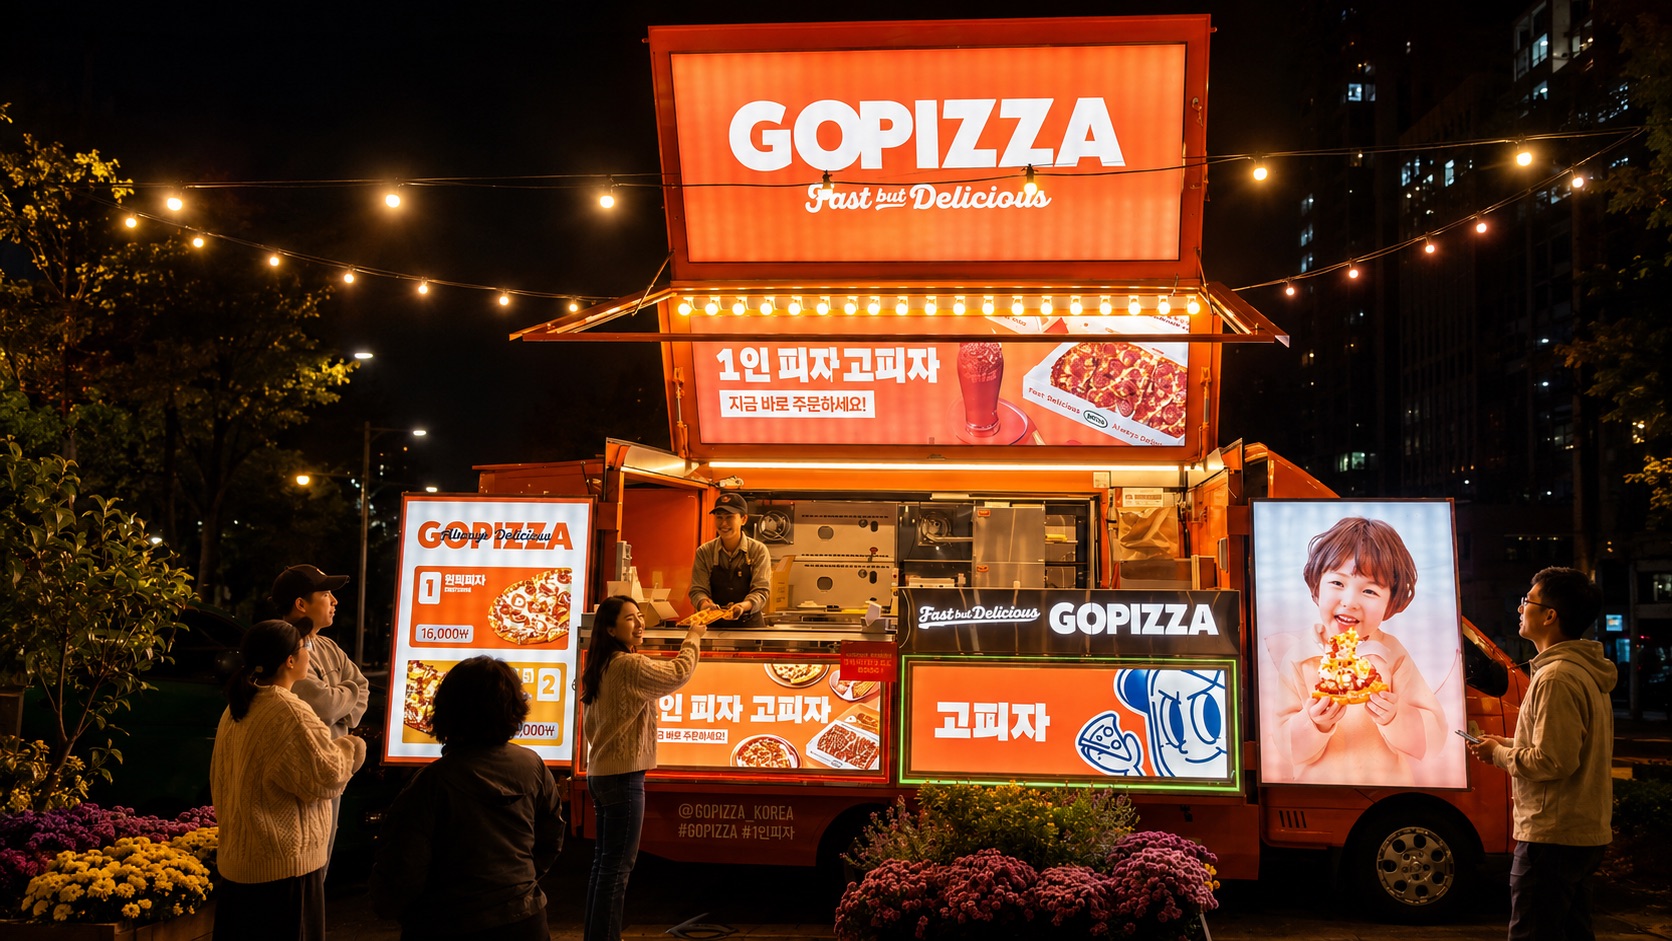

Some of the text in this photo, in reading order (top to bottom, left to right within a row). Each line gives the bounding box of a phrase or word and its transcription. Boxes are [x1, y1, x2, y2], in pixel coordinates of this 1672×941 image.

[729, 97, 1126, 171] GOPIZZA
[805, 183, 1051, 213] Fast but Delicious
[716, 347, 771, 383] 1인
[729, 396, 866, 412] 지금 바로 주문하세요!
[417, 521, 573, 550] GOPIZZA
[426, 579, 434, 597] 1
[919, 605, 1040, 622] Fast but Delicious
[1049, 602, 1219, 636] GOPIZZA
[542, 674, 555, 695] 2
[656, 693, 831, 724] 인 피자 고피자
[517, 724, 555, 738] ,000₩
[934, 701, 1050, 742] 고피자
[678, 803, 794, 822] @GOPIZZA_KOREA
[678, 823, 795, 840] #GOPIZZA #1인피자
